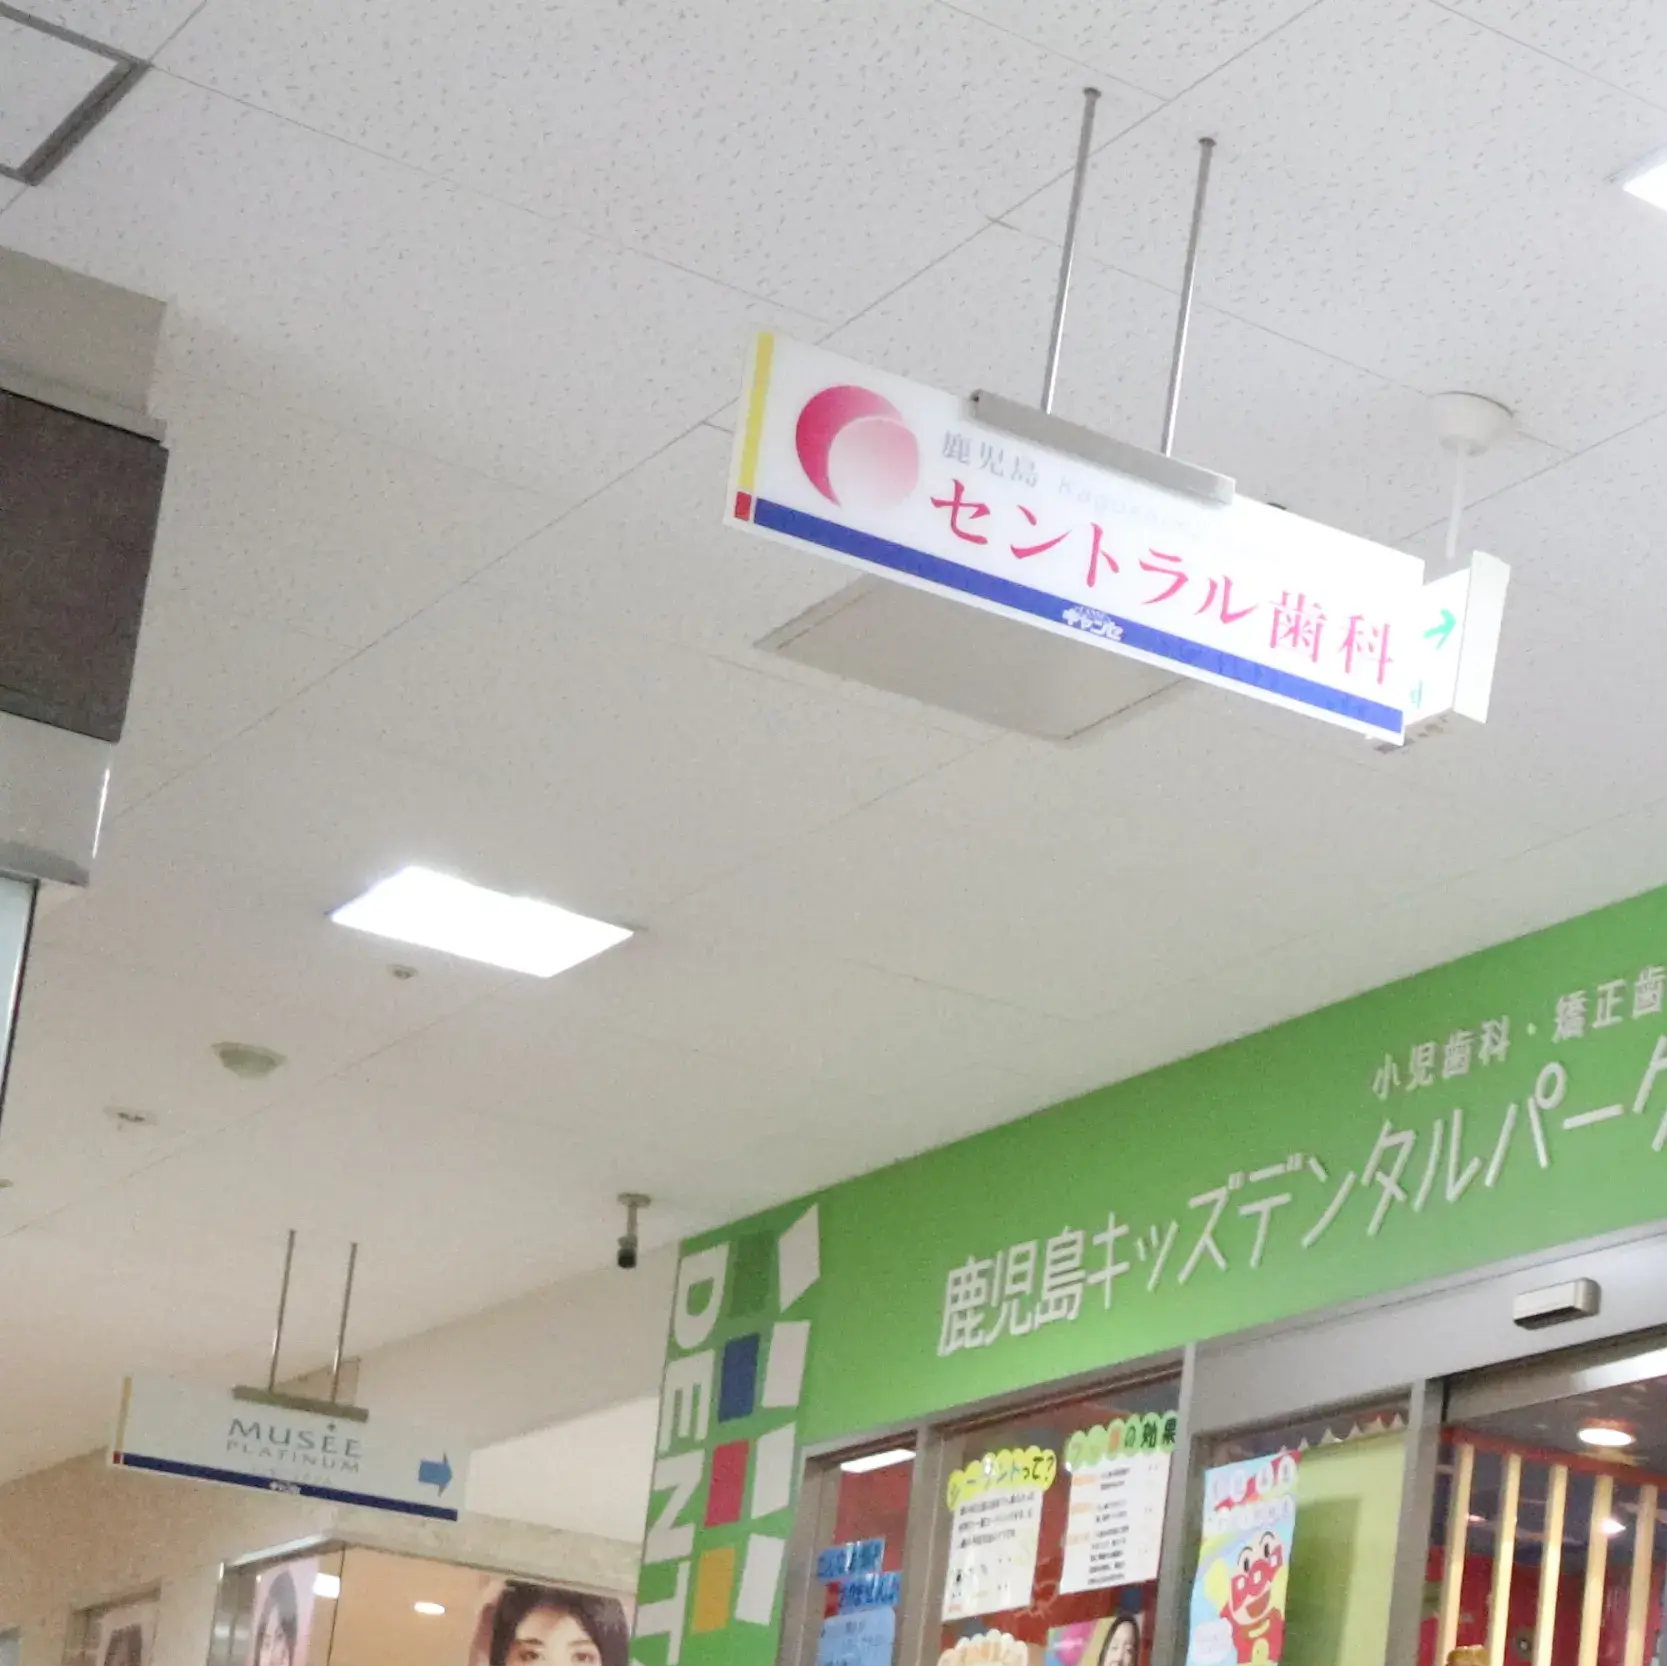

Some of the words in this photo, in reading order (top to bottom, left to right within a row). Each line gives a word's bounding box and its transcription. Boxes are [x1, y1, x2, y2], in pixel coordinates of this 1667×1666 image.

[942, 429, 1040, 489] 鹿児島
[930, 478, 1394, 687] セントラル歯科
[226, 1439, 360, 1474] PLATINUM
